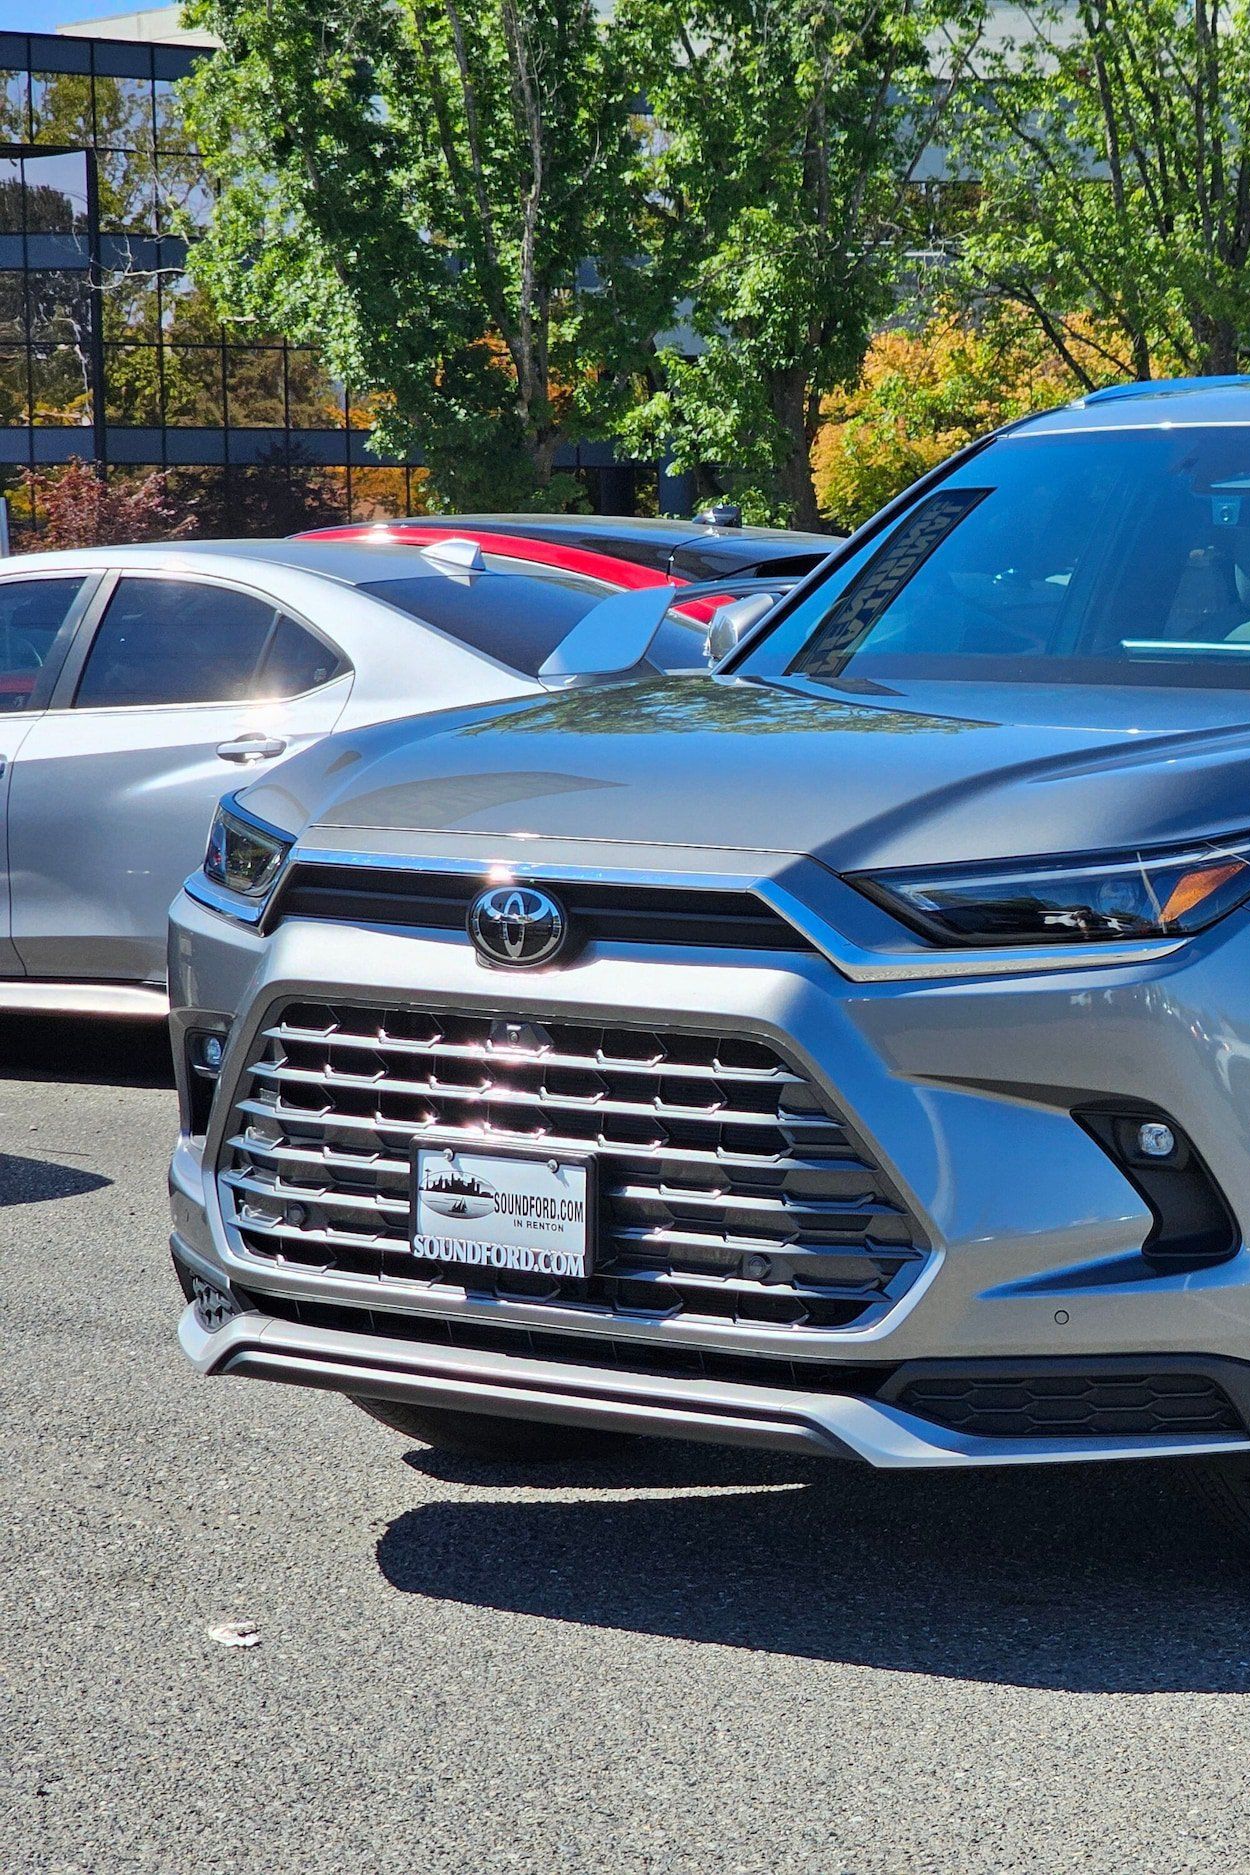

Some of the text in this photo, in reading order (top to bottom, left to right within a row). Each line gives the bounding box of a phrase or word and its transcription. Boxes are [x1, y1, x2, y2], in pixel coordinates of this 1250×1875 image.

[494, 1191, 584, 1223] SOUNDFORD.COM
[513, 1219, 565, 1233] IN RENTON
[413, 1233, 586, 1278] SOUNDFORD.COM
